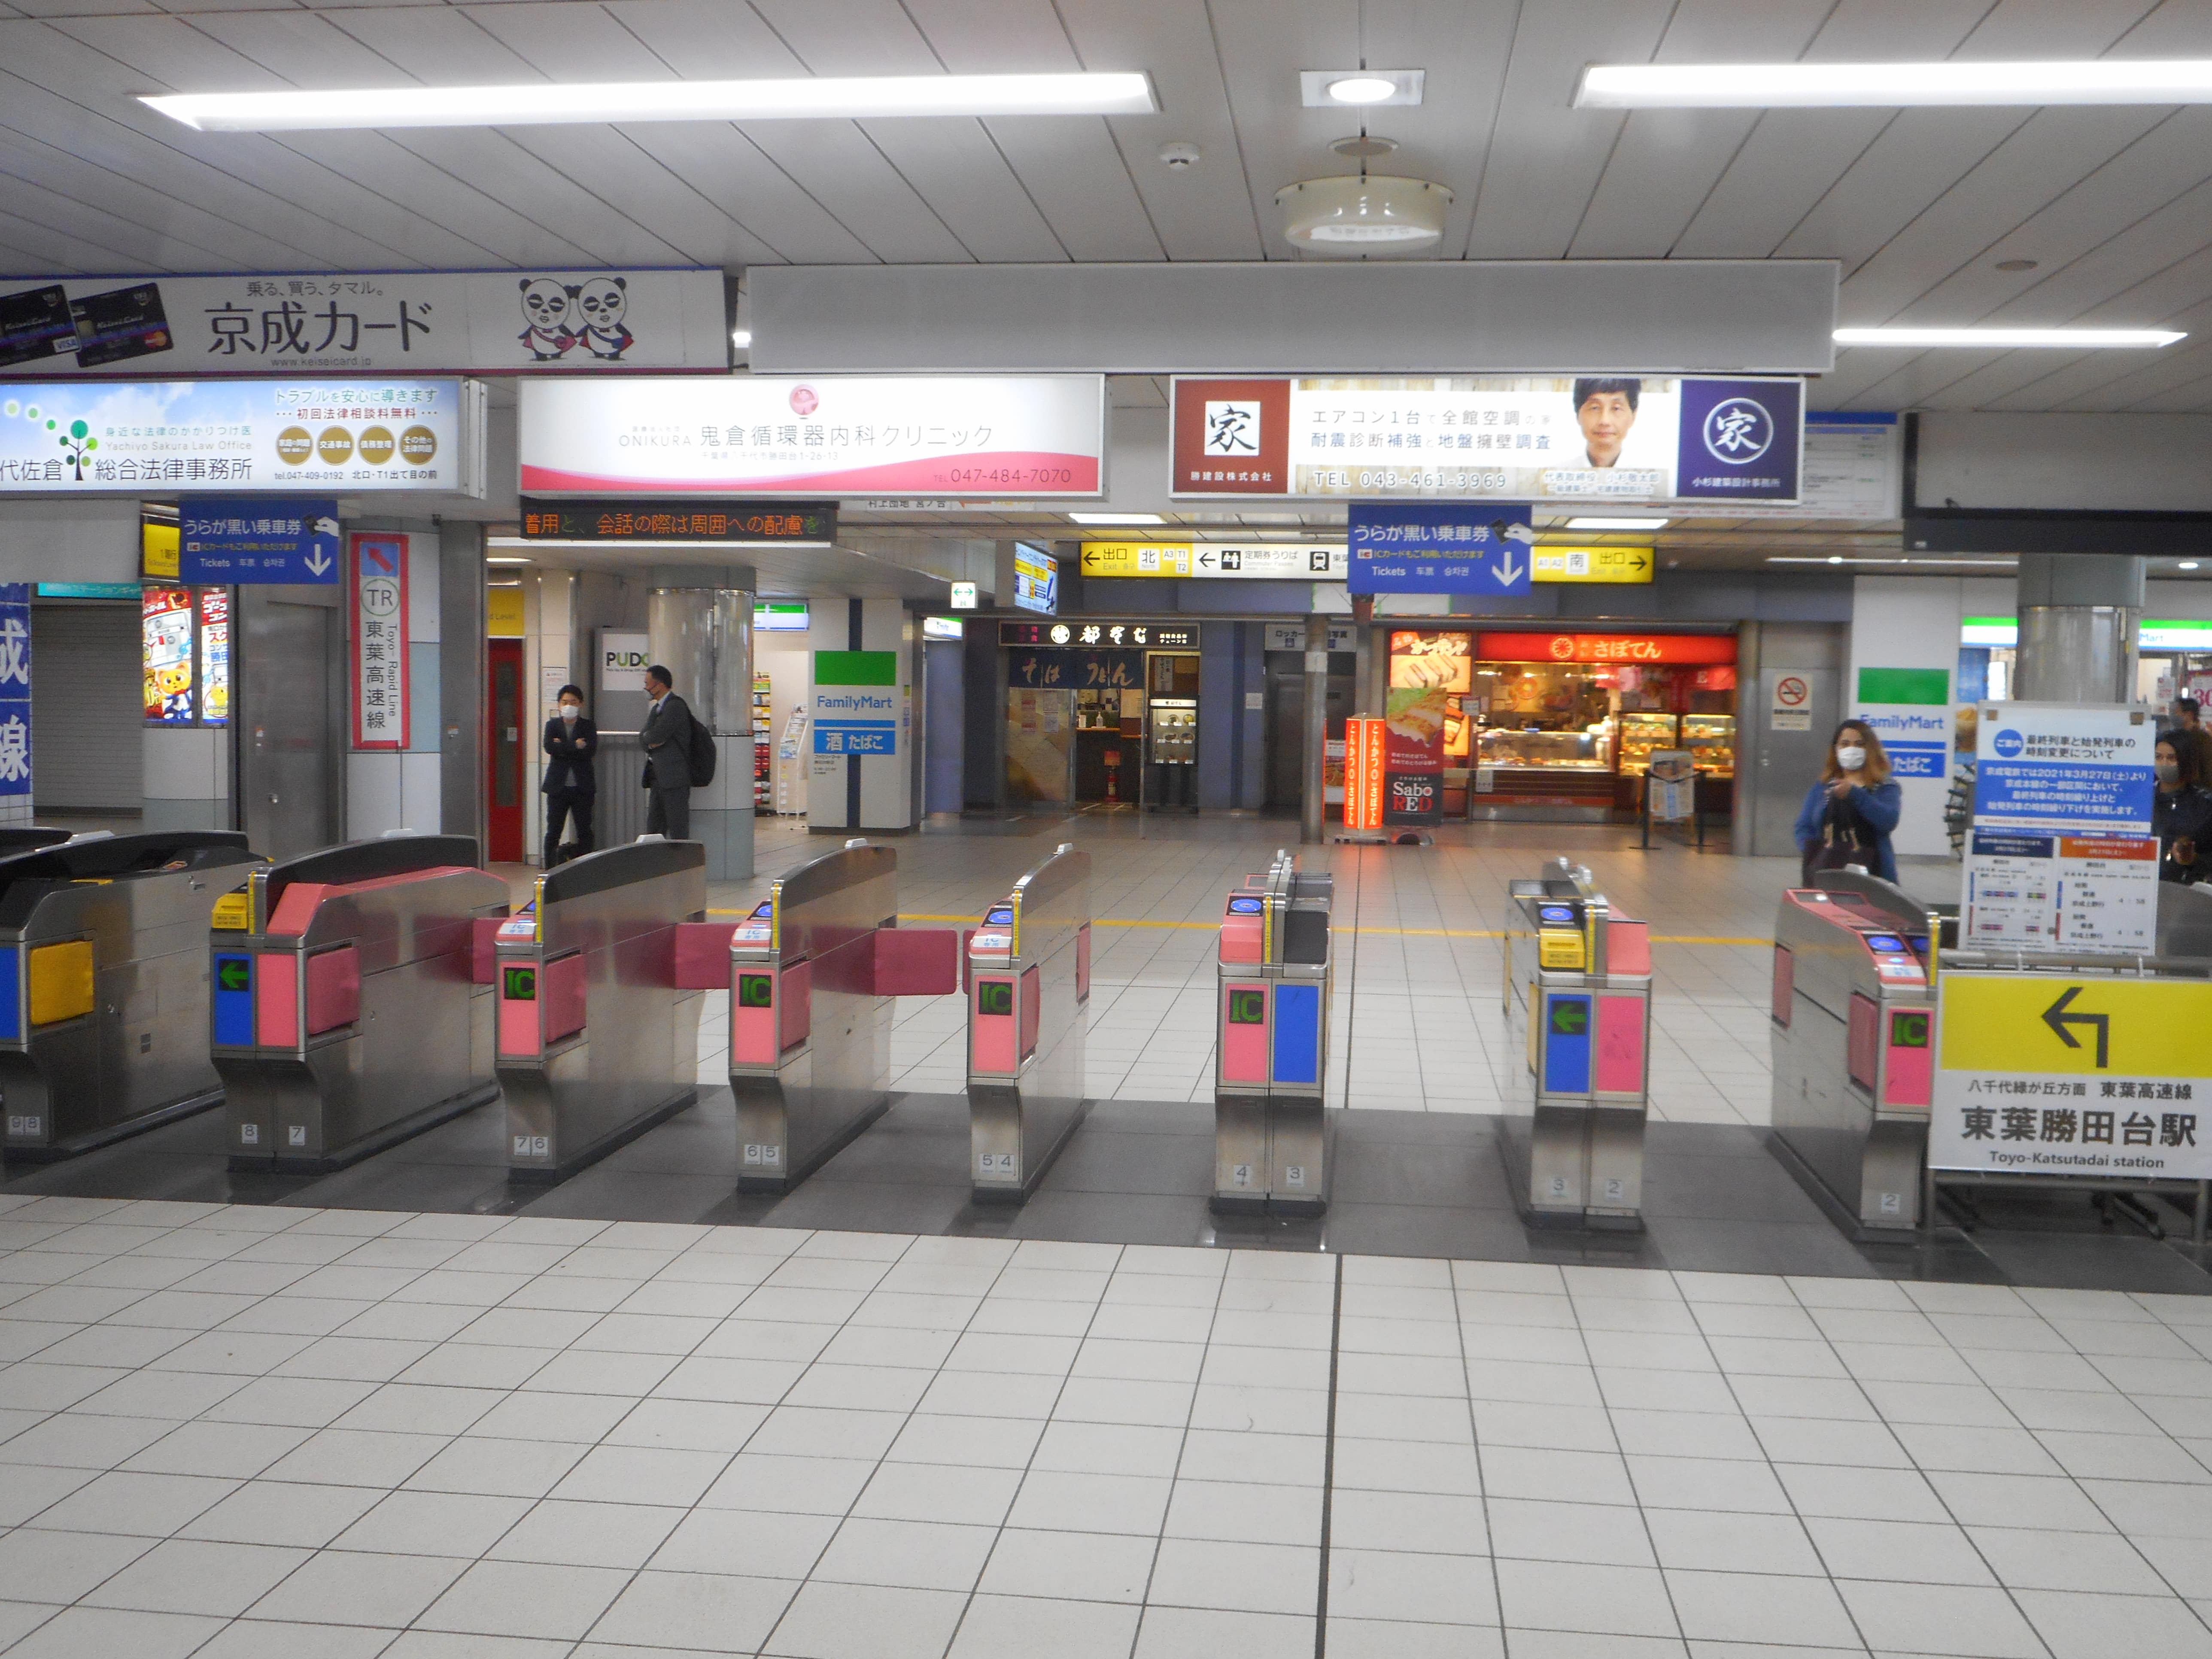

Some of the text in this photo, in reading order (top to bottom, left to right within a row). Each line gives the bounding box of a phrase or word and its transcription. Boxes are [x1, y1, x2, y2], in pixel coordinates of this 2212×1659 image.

[247, 281, 384, 296] 乗る、買う、タマル。
[204, 300, 432, 355] 京成カード
[271, 356, 372, 368] www.keiseicard.jp
[276, 389, 437, 403] トラブルを安心に導きます
[105, 425, 252, 437] 身近な法律のかかりつけ医
[1207, 403, 1257, 452] 家
[1714, 407, 1762, 452] 家
[619, 425, 992, 447] ONIKURA 鬼倉循環器内科クリニック
[1311, 432, 1551, 450] 耐震診断補強と地盤擁壁調査
[105, 440, 252, 452] Yachiyo Sakura Law Office
[95, 459, 252, 481] 総合法律事務所
[274, 471, 343, 480] tel.047-409-0192
[951, 468, 1071, 483] 047-484-7070
[1191, 471, 1272, 482] 勝建設株式会社
[1314, 471, 1506, 488] TEL 043-461-3969
[184, 519, 301, 535] うらが黒い乗車券
[597, 513, 817, 535] 会話の際は周囲への配慮を
[1353, 524, 1490, 542] うらが黒い乗車券
[1103, 548, 1127, 560] 出口
[1142, 550, 1156, 564] 北
[1164, 550, 1174, 559] A3
[1177, 550, 1186, 559] T1
[1245, 550, 1298, 559] 定期券うりば
[1570, 554, 1584, 567] 南
[1600, 552, 1625, 565] 出口
[200, 558, 230, 568] Tickets
[1372, 566, 1406, 576] Tickets
[367, 589, 393, 606] TR
[1275, 629, 1305, 638] ロッカー
[1594, 640, 1662, 659] さぼてん
[366, 621, 386, 729] 東葉高速線
[387, 661, 398, 690] Rapid
[388, 695, 398, 717] Line
[817, 696, 892, 711] FamilyMart
[826, 732, 883, 750] 酒 たばこ
[1371, 723, 1379, 767] とんかつ
[2027, 735, 2136, 748] 最終列車と始発列車の
[2026, 747, 2114, 760] 時刻変更について
[1893, 757, 1932, 773] たばこ
[1392, 781, 1433, 797] Sabo
[1392, 796, 1433, 812] RED
[506, 970, 535, 1000] IC
[741, 977, 771, 1006] IC
[981, 984, 1012, 1013] IC
[1231, 993, 1263, 1022] IC
[1893, 1014, 1928, 1046] IC
[1968, 1080, 2193, 1100] 八千代緑が丘方面 東葉高速線
[12, 1118, 21, 1129] 9
[245, 1126, 254, 1136] 8
[1960, 1106, 2197, 1148] 東葉勝田台駅
[293, 1127, 301, 1138] 7
[518, 1137, 544, 1149] 7 6
[747, 1146, 775, 1158] 6 5
[983, 1155, 1011, 1168] 5 4
[1990, 1151, 2164, 1169] Toyo-Katsutadai station
[1236, 1166, 1247, 1178] 4
[1290, 1167, 1300, 1180] 3
[1553, 1179, 1565, 1192] 3
[1608, 1179, 1621, 1193] 2
[1885, 1194, 1896, 1207] 2
